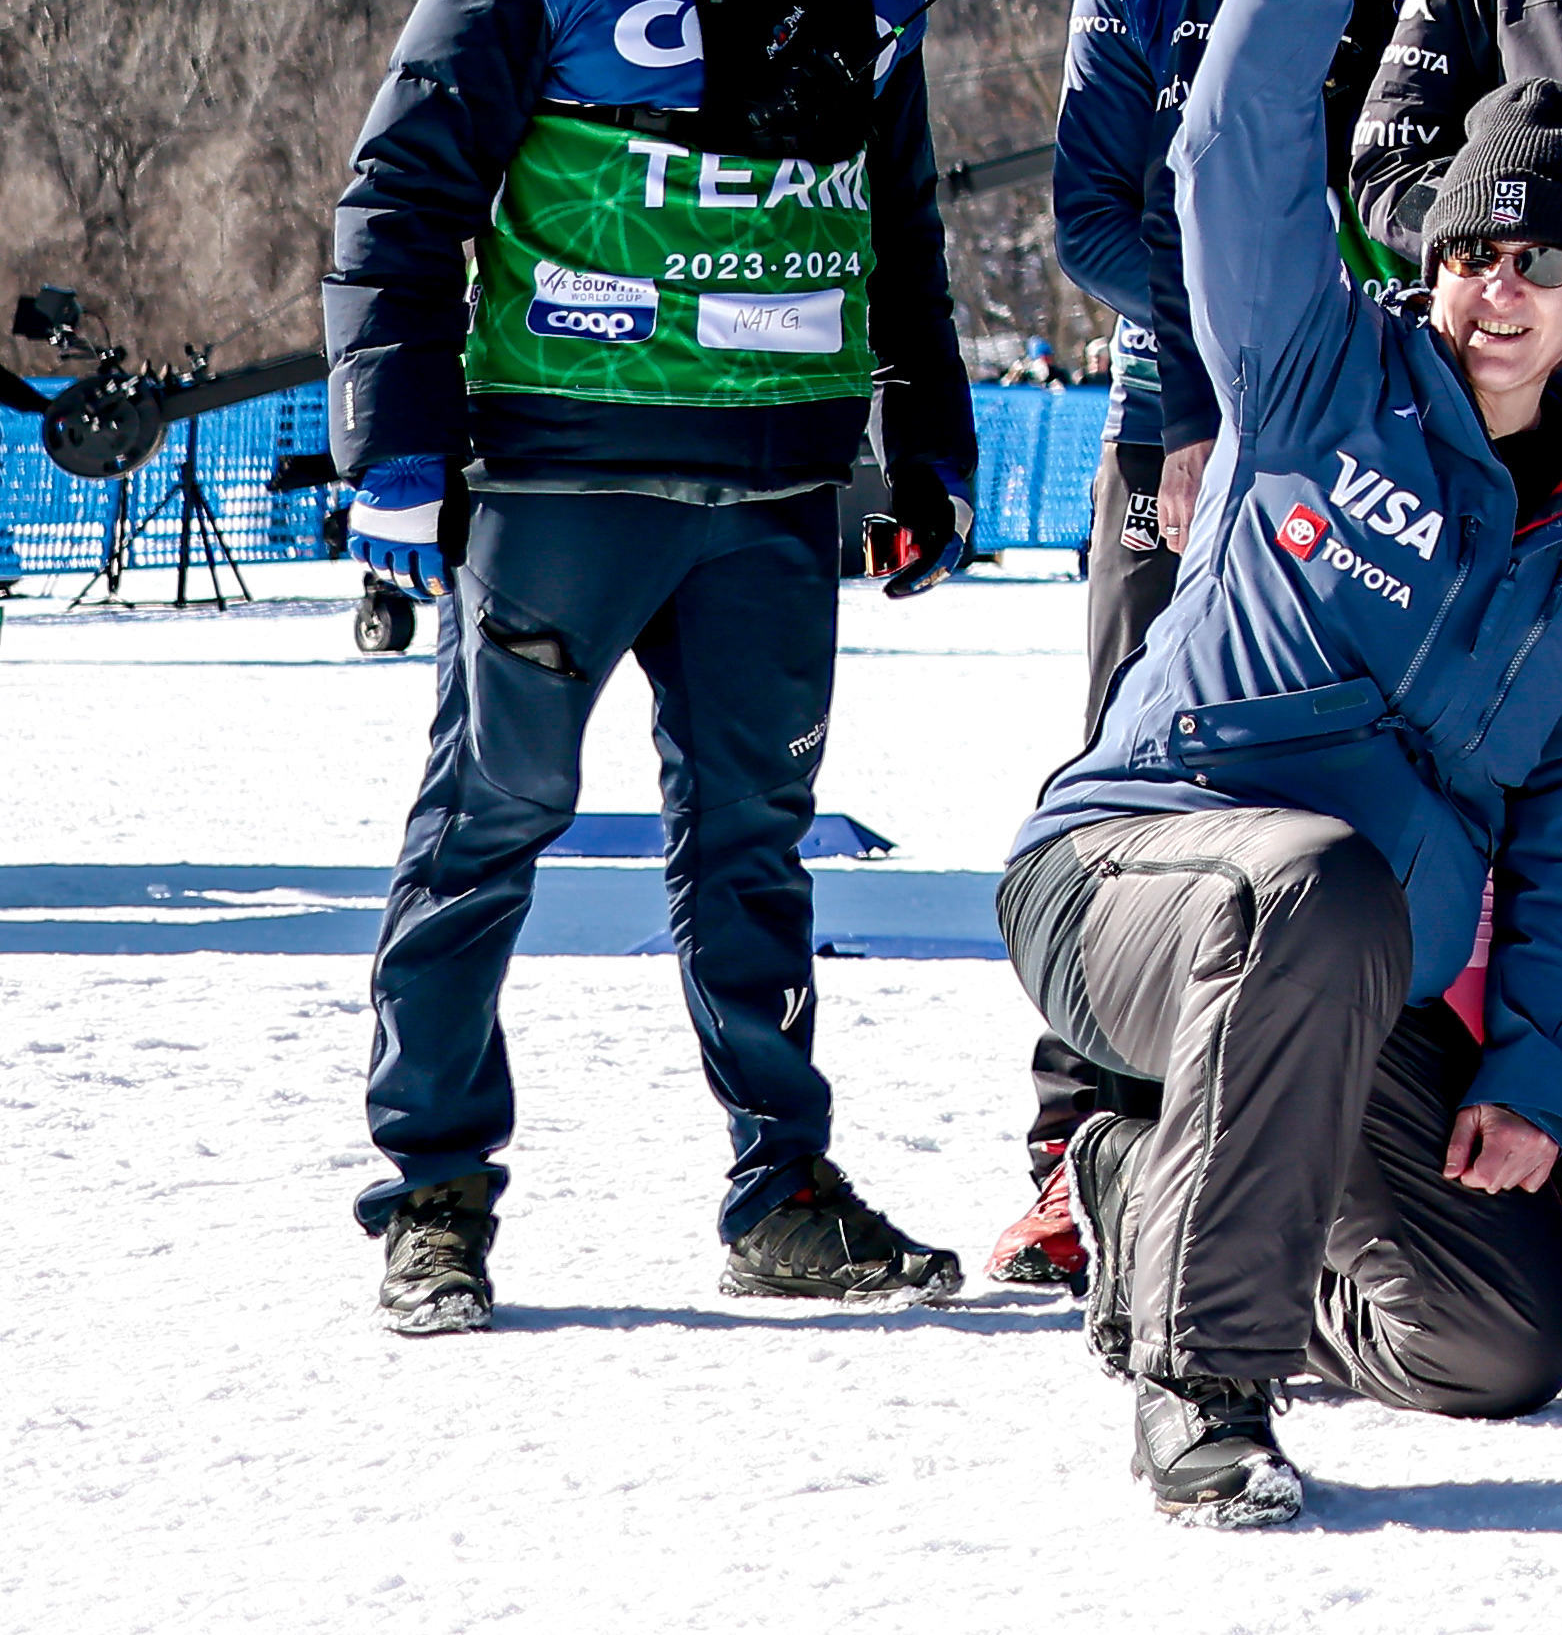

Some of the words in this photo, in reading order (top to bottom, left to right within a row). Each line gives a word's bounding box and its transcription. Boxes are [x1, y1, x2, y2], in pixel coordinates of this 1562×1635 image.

[629, 139, 869, 211] TEAM
[1497, 182, 1526, 197] US
[547, 310, 636, 337] coop
[1131, 494, 1158, 516] US
[1335, 449, 1444, 561] VISA
[1320, 537, 1413, 609] TOYOTA
